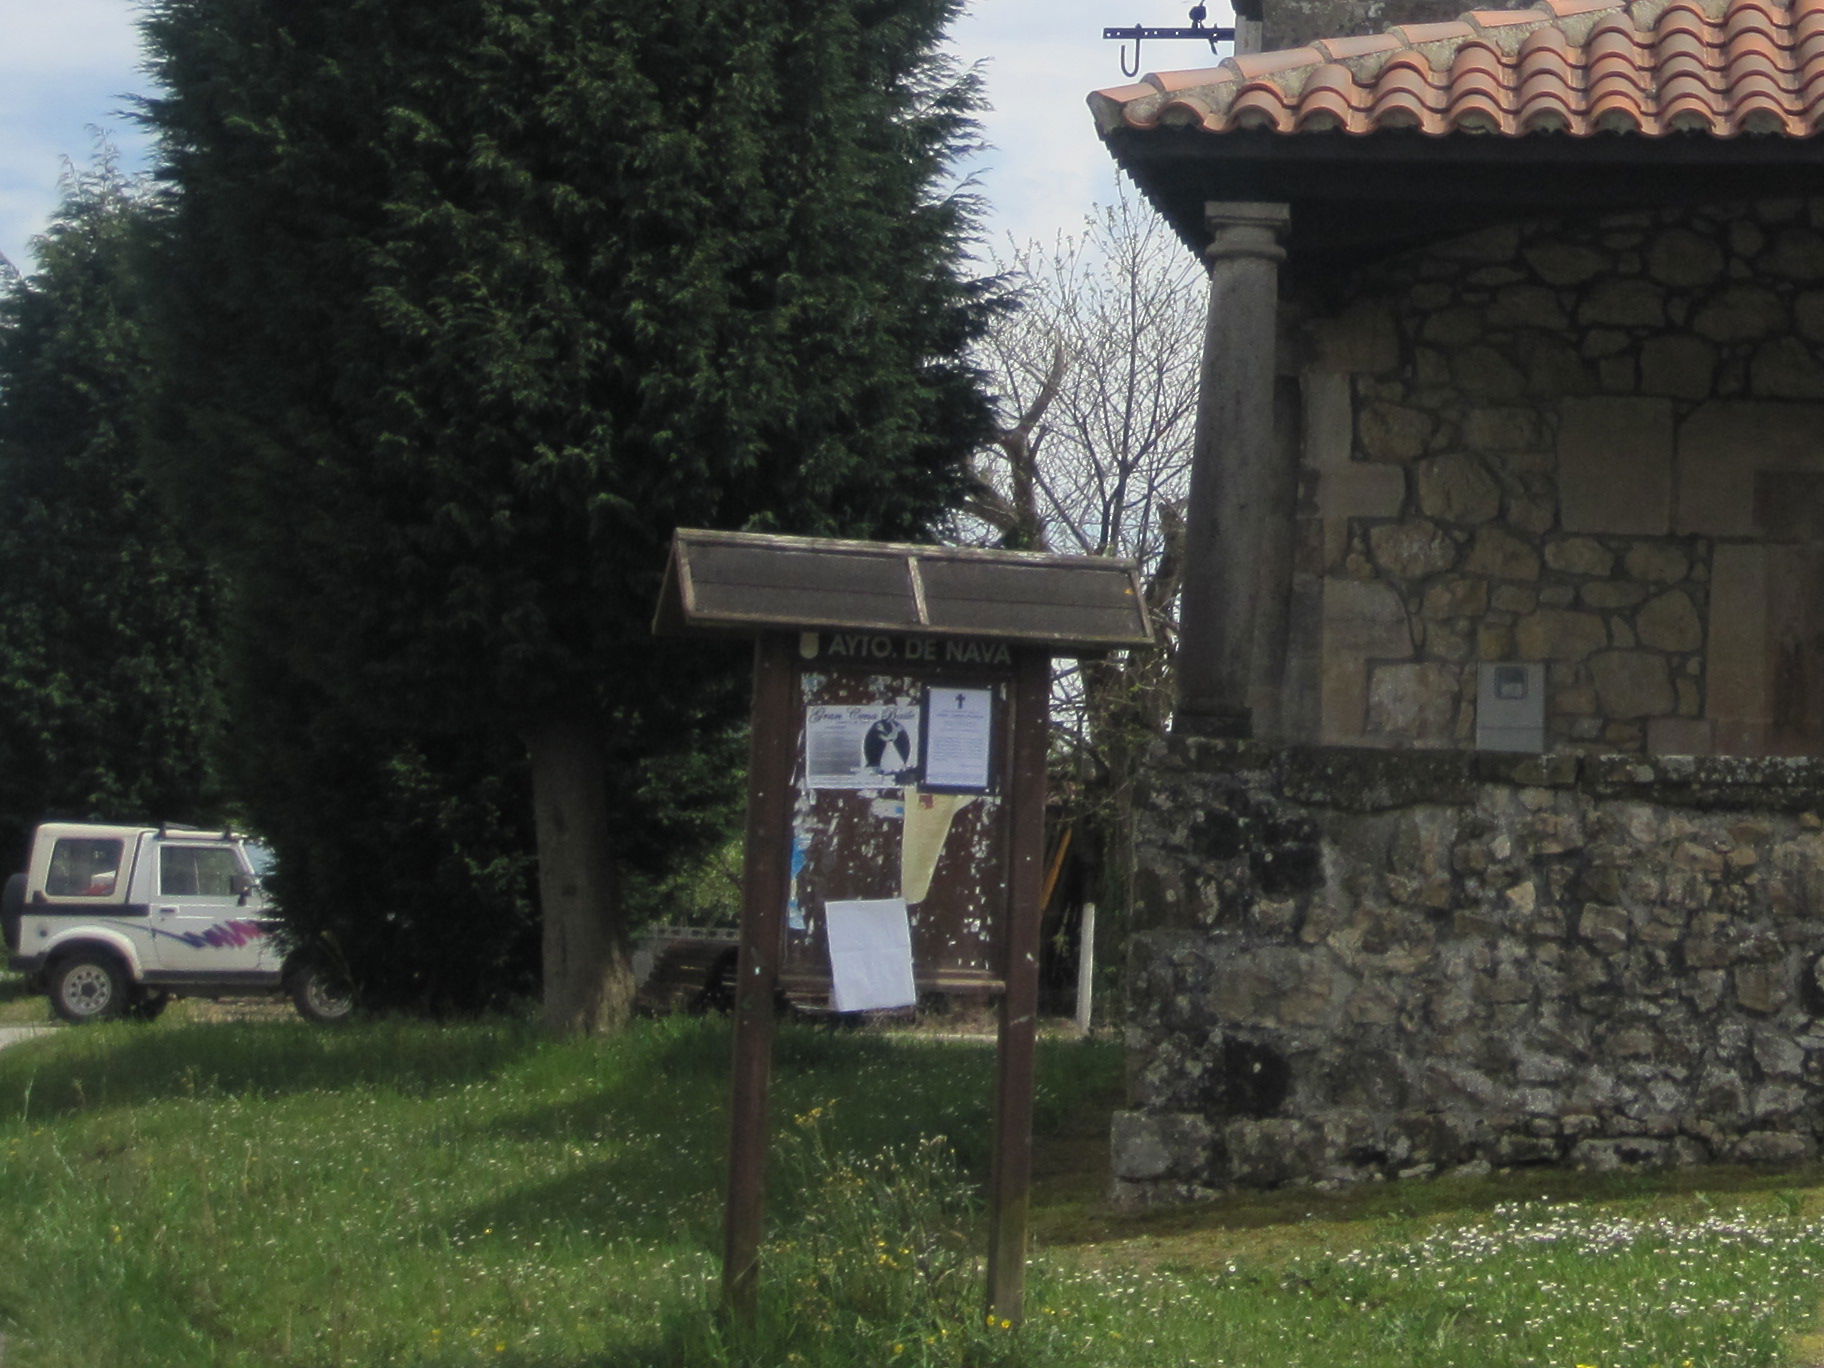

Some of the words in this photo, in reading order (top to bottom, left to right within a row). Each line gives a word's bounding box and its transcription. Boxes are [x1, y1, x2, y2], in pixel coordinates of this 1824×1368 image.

[828, 633, 896, 658] AYTO.
[906, 638, 936, 661] DE
[946, 640, 1011, 665] NAVA
